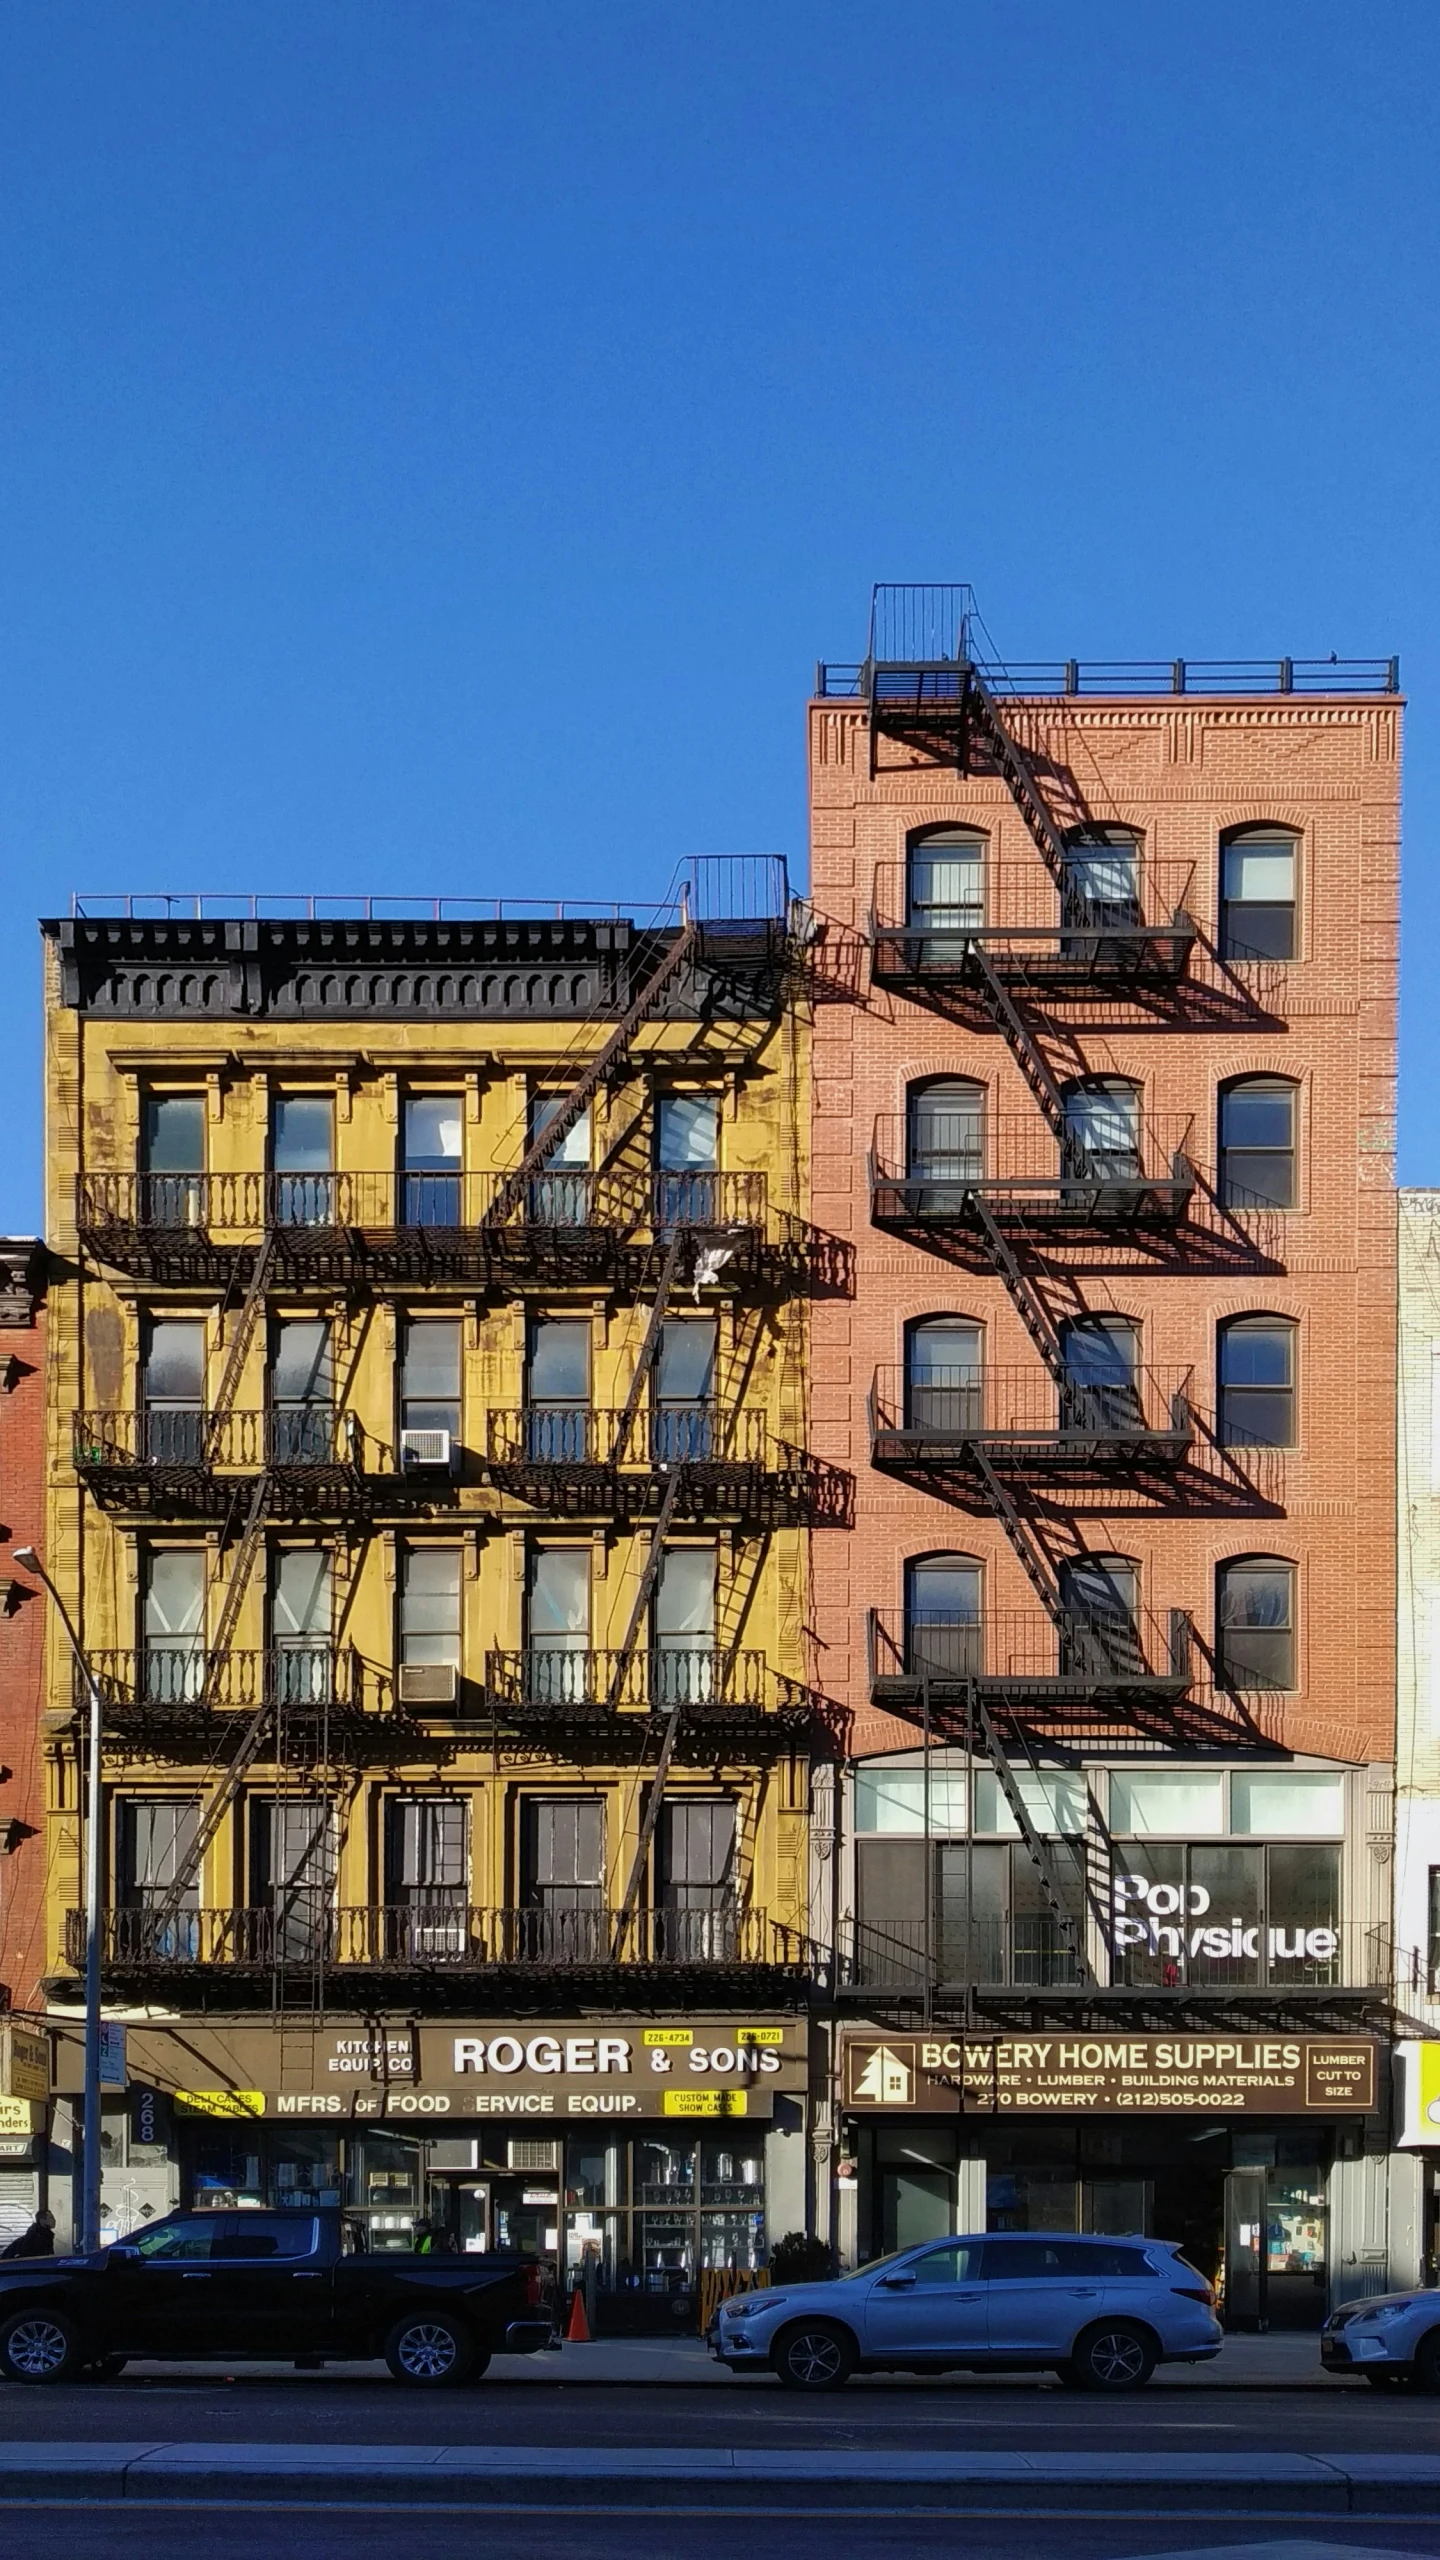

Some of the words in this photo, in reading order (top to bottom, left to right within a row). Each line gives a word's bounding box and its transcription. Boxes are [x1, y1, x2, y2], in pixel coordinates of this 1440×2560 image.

[1114, 1874, 1210, 1923] Pop
[1114, 1917, 1338, 1967] Physique
[648, 2033, 690, 2043] 226-4734
[741, 2031, 780, 2041] 226-0721
[336, 2040, 409, 2054] KITCHEN
[454, 2036, 631, 2073] ROGER
[651, 2049, 671, 2072] &
[689, 2047, 780, 2073] SONS
[922, 2043, 1052, 2068] BOWERY
[1059, 2044, 1148, 2069] HOME
[1155, 2043, 1301, 2069] SUPPLIES
[1313, 2055, 1366, 2065] LUMBER
[927, 2075, 1021, 2086] HARDWARE
[1037, 2075, 1106, 2086] LUMBER
[1121, 2075, 1199, 2086] BUILDING
[1203, 2075, 1295, 2087] MATERIALS
[1316, 2071, 1342, 2080] CUT
[1344, 2071, 1361, 2080] TO
[1325, 2087, 1353, 2096] SIZE
[216, 2094, 252, 2103] CASES
[674, 2094, 710, 2102] CUSTOM
[713, 2094, 737, 2102] MADE
[977, 2093, 1012, 2106] 270
[1016, 2093, 1098, 2106] BOWERY
[1116, 2093, 1245, 2107] (212)505-0022
[181, 2104, 215, 2113] STEAM
[220, 2104, 259, 2113] TABLES
[277, 2095, 347, 2112] MFRS.
[355, 2099, 376, 2112] OF
[387, 2095, 450, 2112] FOOD
[568, 2095, 642, 2113] EQUIP.
[679, 2103, 703, 2112] SHOW
[707, 2103, 733, 2112] CASES
[141, 2093, 154, 2142] 268
